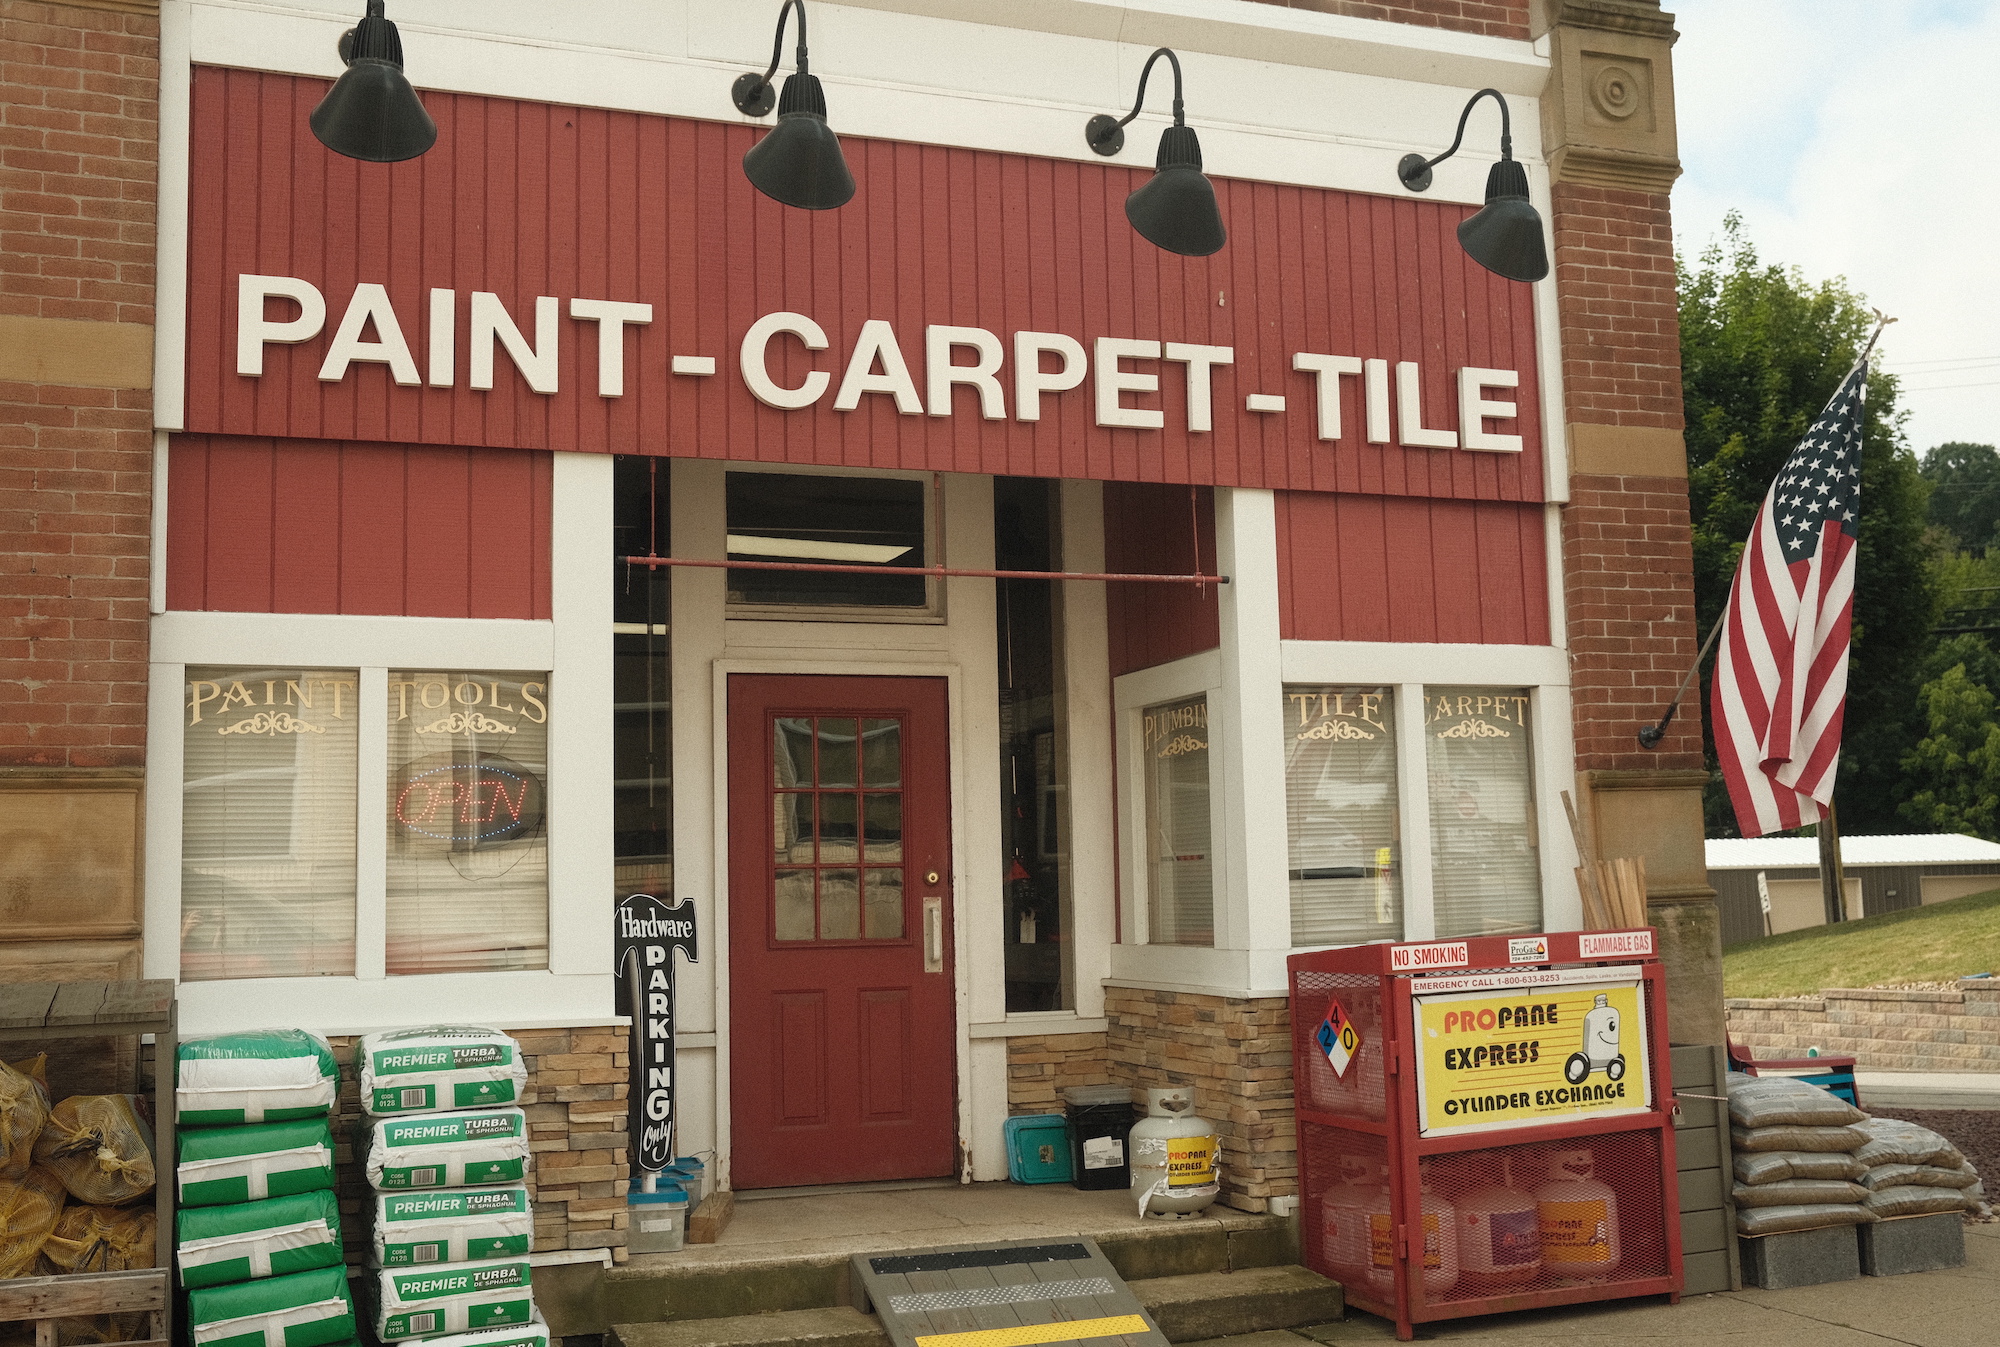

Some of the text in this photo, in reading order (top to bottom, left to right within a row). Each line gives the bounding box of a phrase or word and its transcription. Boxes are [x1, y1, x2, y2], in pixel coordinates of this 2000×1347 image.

[236, 273, 653, 399] PAINT
[739, 311, 1234, 433] CARPET
[1292, 351, 1523, 453] TILE
[186, 679, 357, 727] PAINT
[387, 679, 548, 725] TOOLS
[1288, 693, 1388, 734] TILE
[395, 779, 528, 824] OPEN
[619, 906, 694, 939] Hardware
[1511, 944, 1537, 955] ProGas
[1583, 934, 1649, 954] FLAMMABLE GAS
[1393, 946, 1466, 967] NO SMOKING
[1413, 979, 1469, 991] EMERGENCY
[1472, 977, 1494, 987] CALL
[1497, 973, 1560, 986] 1-800-633-8253
[1331, 1005, 1340, 1028] 4
[1444, 1003, 1558, 1034] PROPANE
[645, 945, 671, 1122] PARKING
[1323, 1025, 1331, 1047] 2
[1343, 1027, 1353, 1050] 0
[382, 1053, 447, 1069] PREMIER
[453, 1048, 496, 1057] TURBA
[464, 1055, 503, 1063] SPHAGNUM
[1445, 1040, 1540, 1070] EXPRESS
[379, 1099, 396, 1107] 0128
[1444, 1092, 1530, 1116] CYLINDER
[1535, 1082, 1625, 1107] EXCHANGE
[393, 1124, 460, 1140] PREMIER
[464, 1118, 508, 1129] TURBA
[643, 1119, 673, 1163] Only
[1169, 1150, 1207, 1160] PROPANE
[1169, 1161, 1202, 1172] EXPRESS
[394, 1199, 460, 1214] PREMIER
[466, 1193, 509, 1204] TURBA
[477, 1201, 517, 1209] SPHAGNUM
[390, 1255, 408, 1263] 0128
[473, 1267, 517, 1281] TURBA
[400, 1276, 468, 1295] PREMIER
[387, 1326, 405, 1335] 0128
